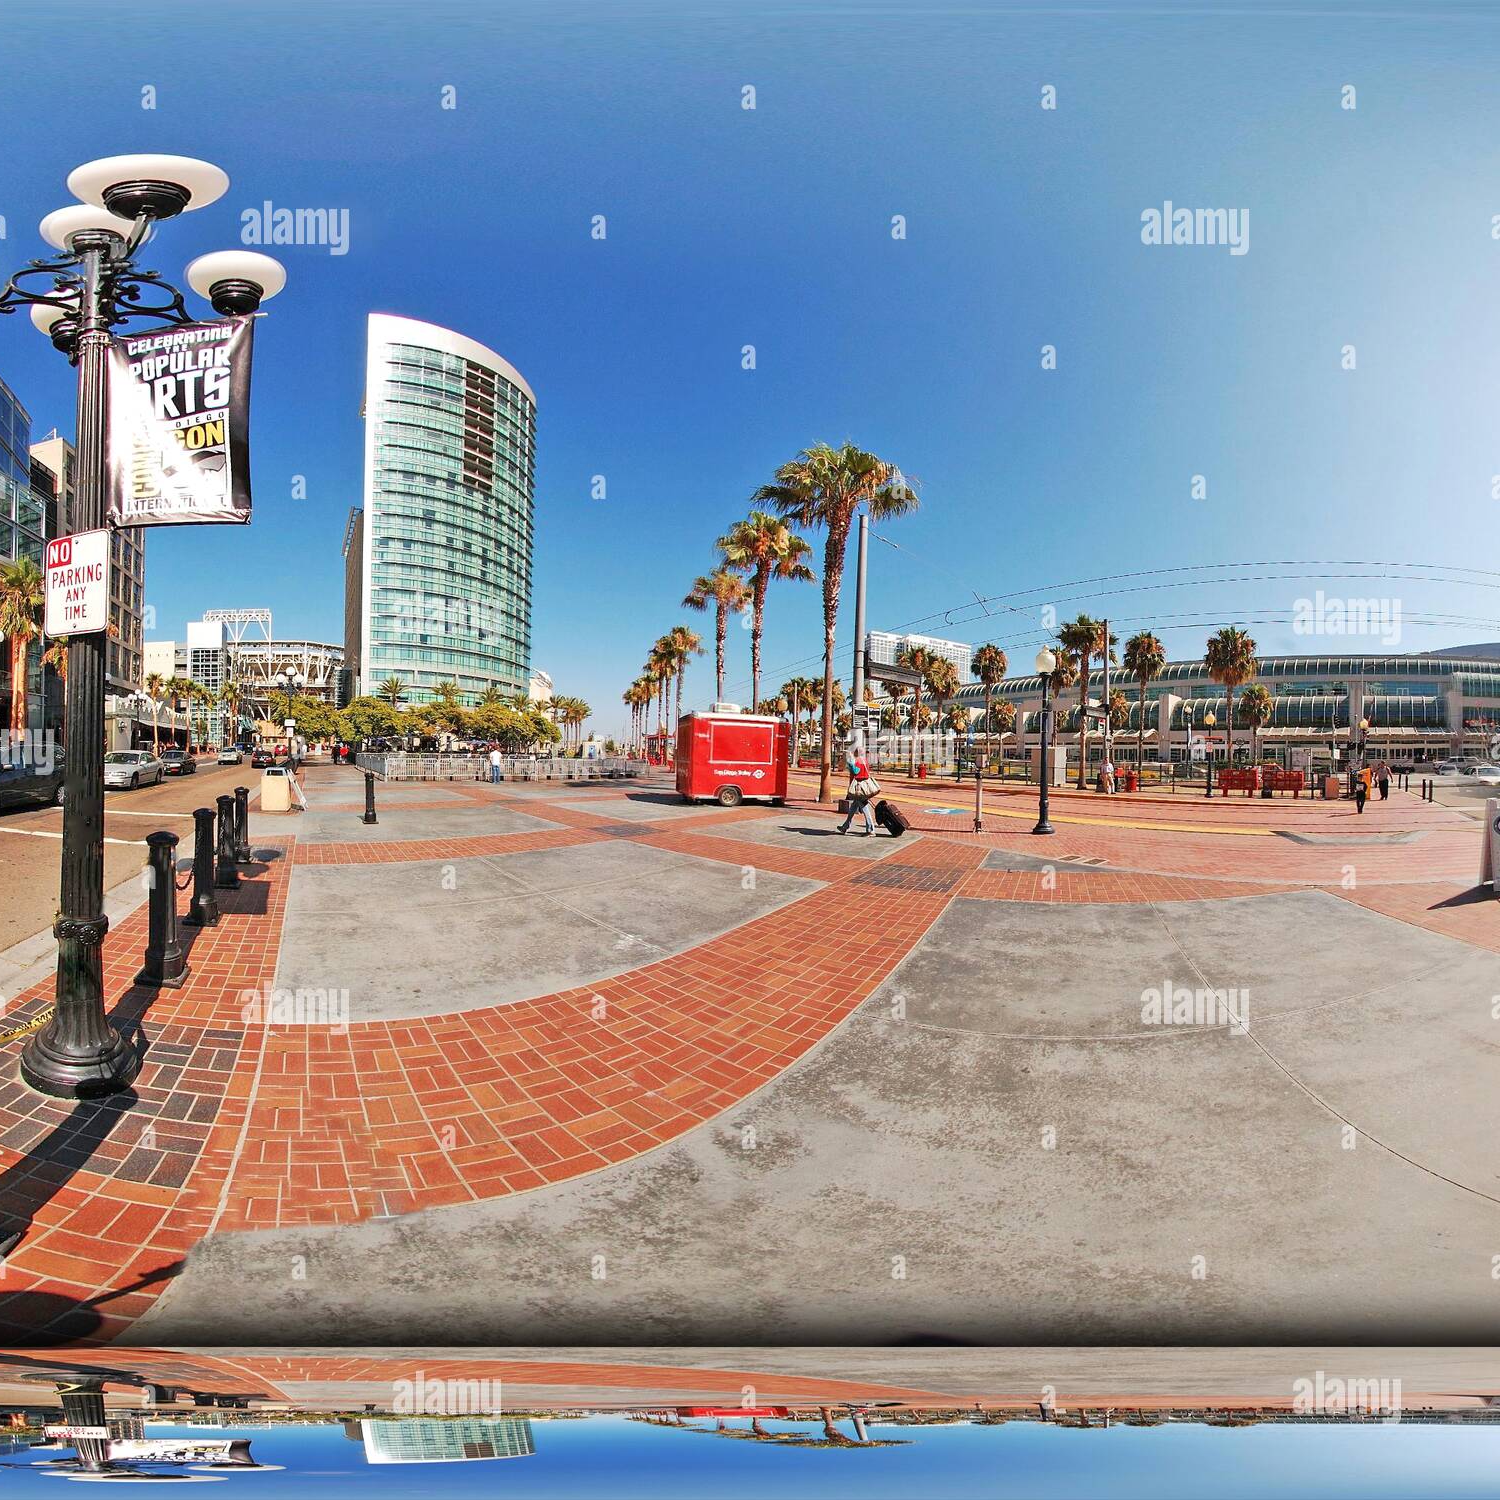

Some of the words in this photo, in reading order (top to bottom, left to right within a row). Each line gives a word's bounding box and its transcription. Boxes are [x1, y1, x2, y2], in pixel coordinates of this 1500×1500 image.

[127, 327, 232, 356] CELEBRATING
[165, 344, 188, 353] THE
[129, 346, 231, 382] POPULAR
[175, 411, 224, 428] DIEGO
[50, 542, 70, 565] NO
[52, 563, 102, 589] PARKING
[66, 586, 87, 603] ANY
[64, 604, 87, 620] TIME
